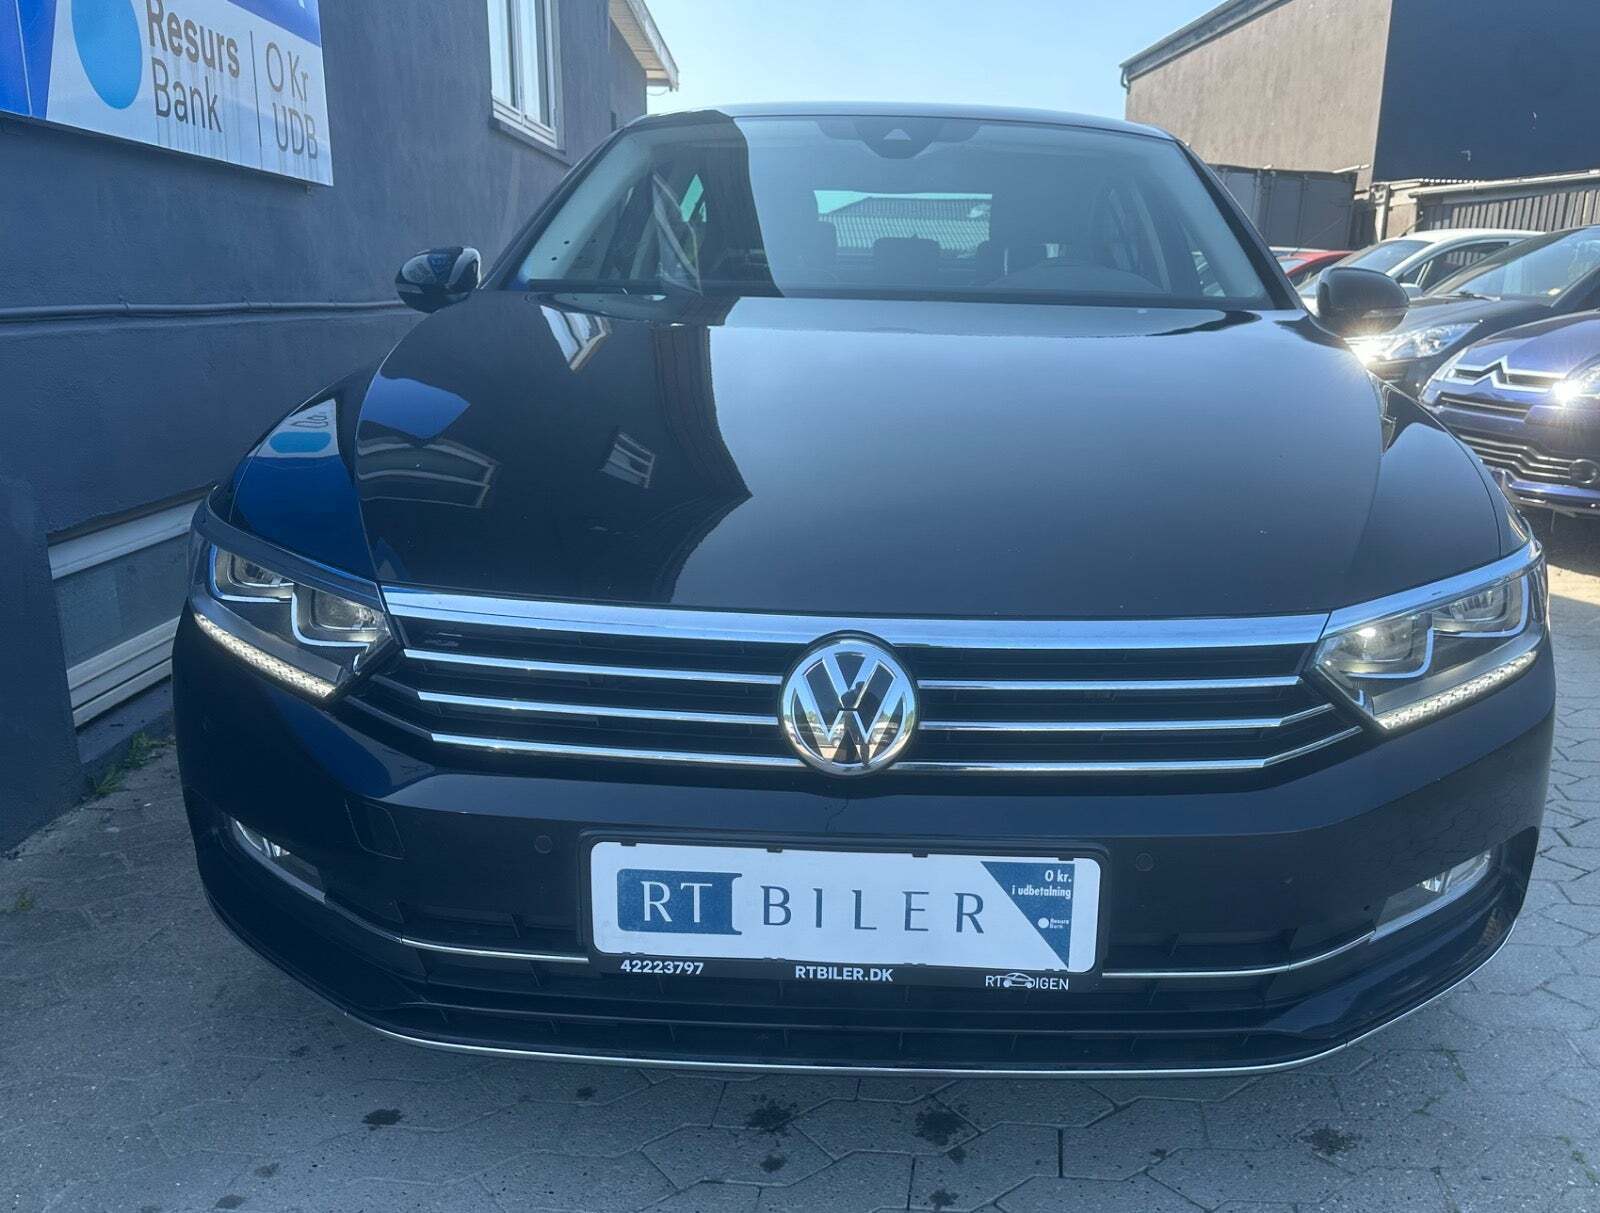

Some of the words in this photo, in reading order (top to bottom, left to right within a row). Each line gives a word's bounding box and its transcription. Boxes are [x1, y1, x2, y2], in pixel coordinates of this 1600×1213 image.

[146, 0, 240, 78] Resurs
[151, 56, 222, 133] Bank
[272, 102, 318, 160] UDB
[1017, 884, 1072, 900] udbetalning
[1056, 869, 1072, 883] kr.
[639, 880, 713, 923] RT
[760, 885, 985, 934] BILER
[620, 959, 704, 976] 42223797
[795, 965, 894, 982] RTBILER.DK
